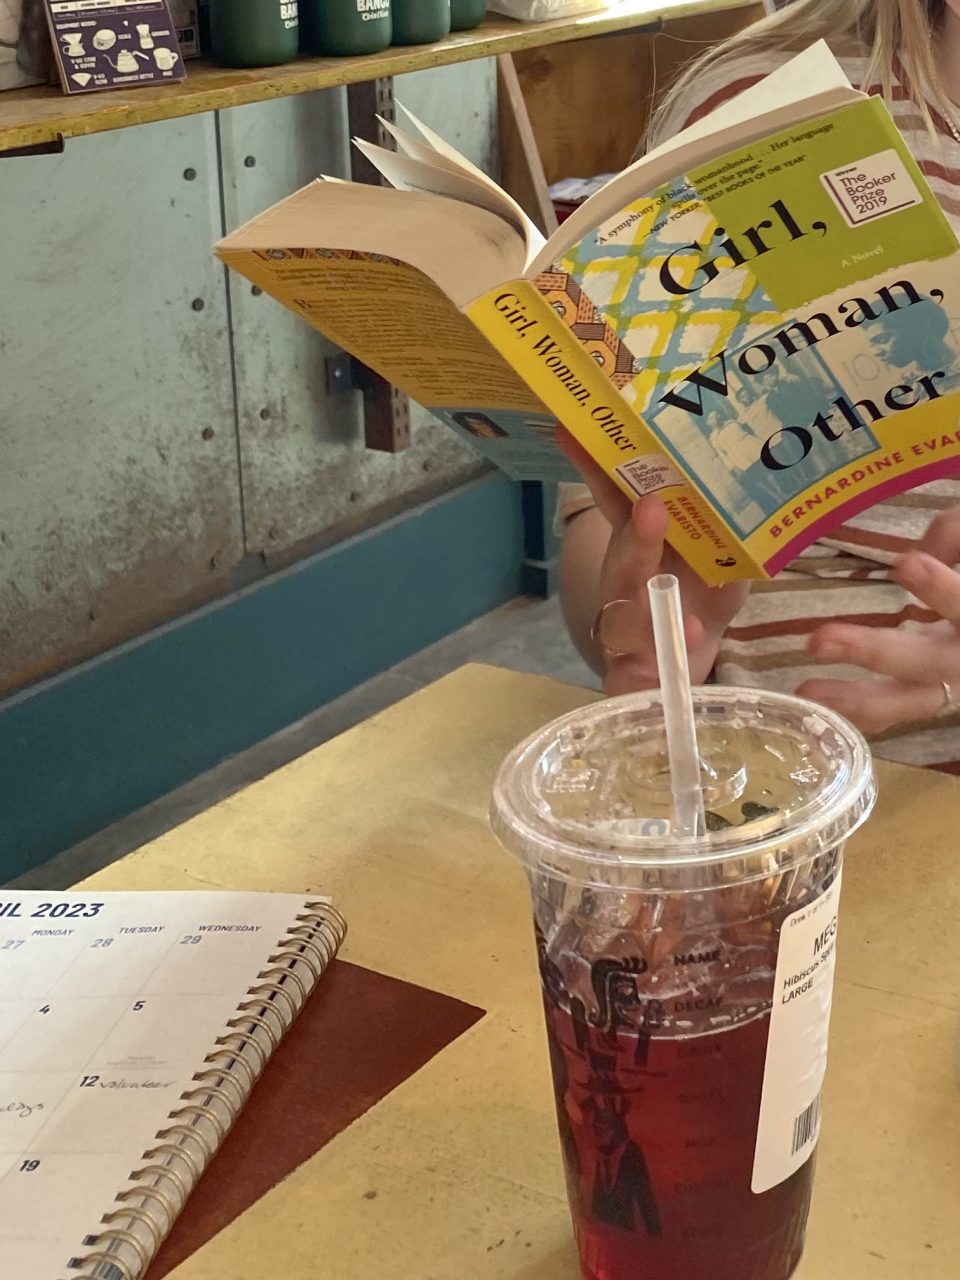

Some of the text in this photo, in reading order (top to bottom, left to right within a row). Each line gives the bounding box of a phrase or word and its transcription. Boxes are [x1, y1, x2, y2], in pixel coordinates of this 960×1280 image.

[608, 205, 656, 239] symphony
[655, 194, 667, 207] of
[664, 183, 693, 202] black
[693, 154, 755, 185] womanhood
[769, 139, 791, 153] Her
[788, 122, 835, 144] language
[671, 191, 697, 210] spills
[697, 181, 718, 196] over
[718, 173, 736, 187] the
[725, 176, 755, 196] BOOKS
[754, 169, 767, 182] OF
[840, 173, 867, 188] The
[845, 171, 897, 197] Booker
[851, 188, 885, 206] Prize
[855, 196, 888, 214] 2019
[659, 199, 828, 296] Girl,
[851, 245, 884, 261] Novel
[656, 278, 945, 418] Woman,
[494, 292, 637, 453] Girl, Woman, Other
[759, 369, 947, 472] Other
[769, 452, 905, 539] BERNARDINE
[664, 499, 702, 540] EVARISTO
[678, 496, 727, 549] BERNARDINE
[30, 902, 104, 918] 2023
[1, 935, 202, 950] 27 28 29
[31, 925, 262, 937] MONDAY TUESDAY WEDNESDAY
[674, 948, 721, 966] NAME
[783, 959, 820, 990] Hibiscus
[781, 976, 815, 1005] LARGE
[38, 1000, 146, 1014] 4 5
[79, 1075, 100, 1088] 12
[19, 1159, 41, 1172] 19
